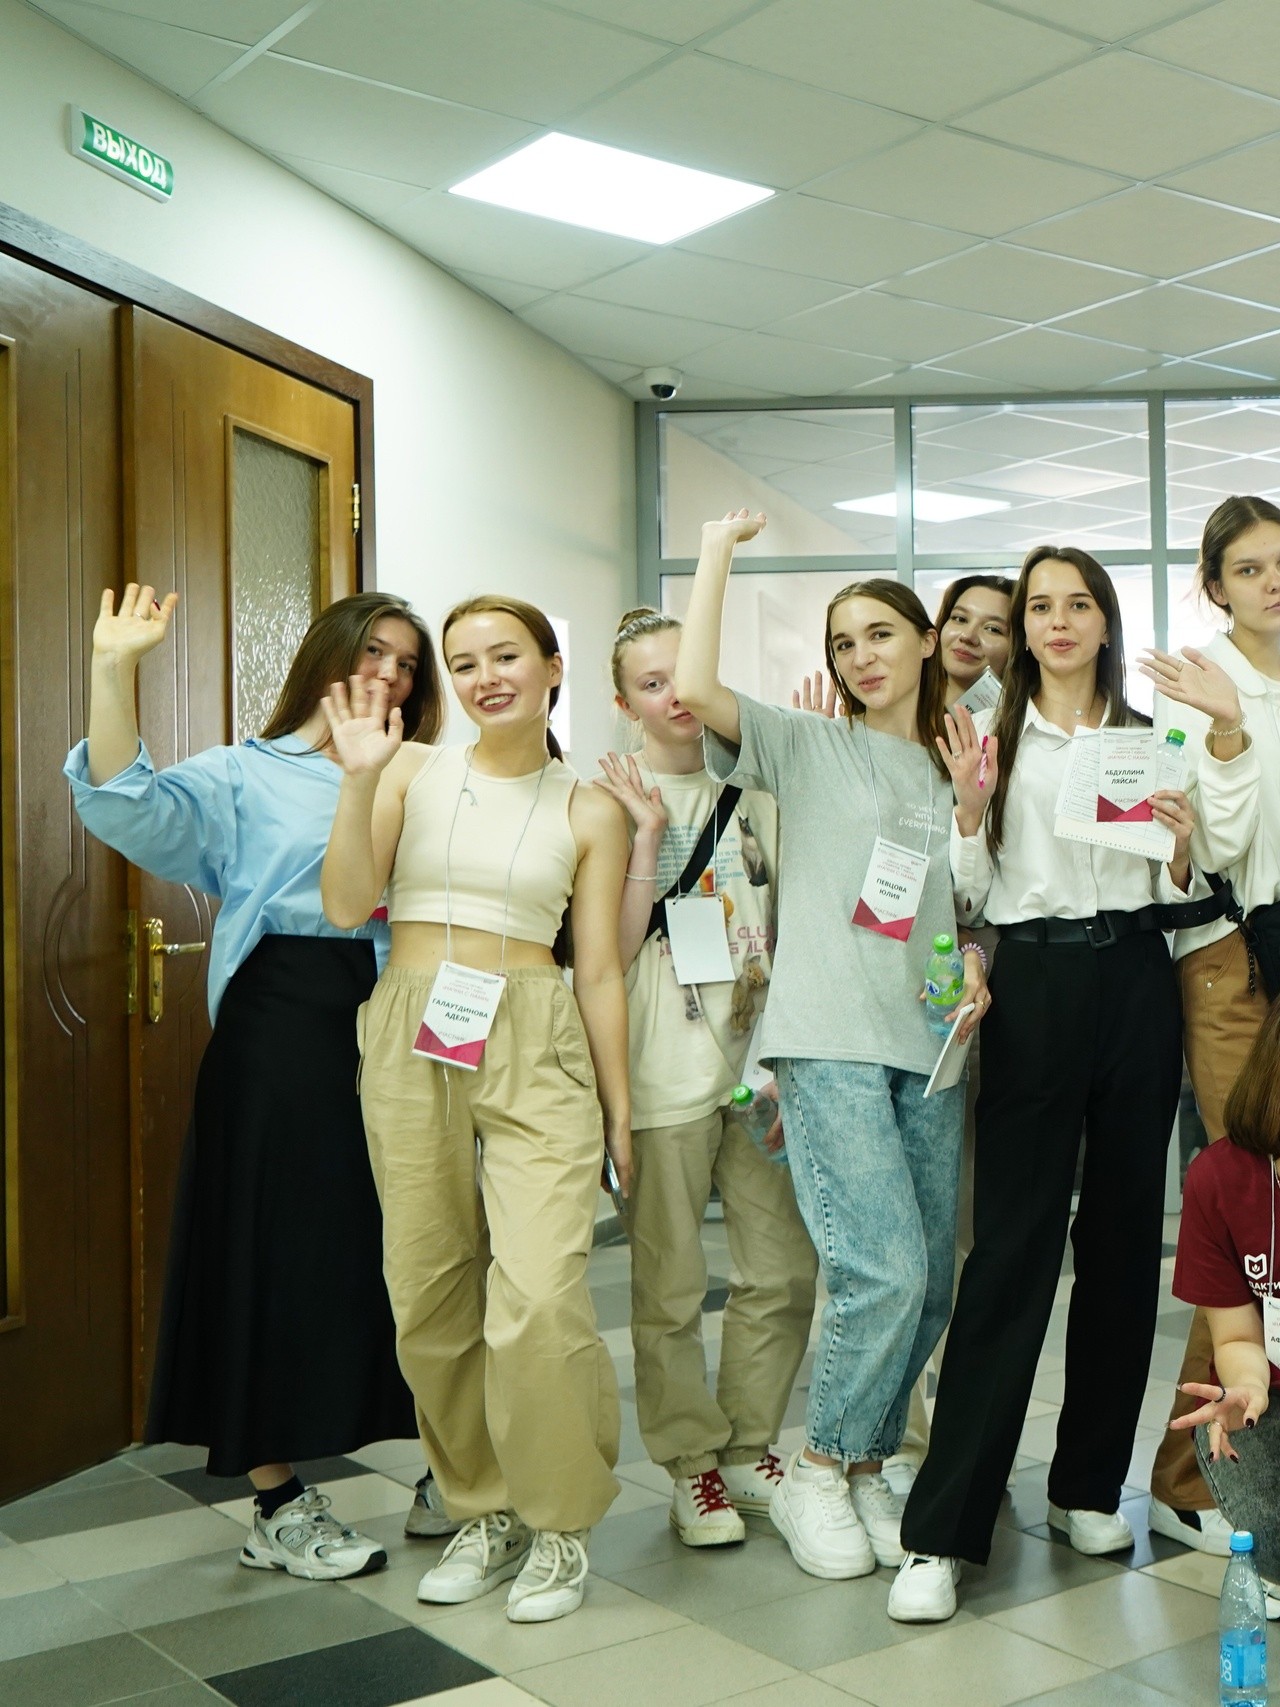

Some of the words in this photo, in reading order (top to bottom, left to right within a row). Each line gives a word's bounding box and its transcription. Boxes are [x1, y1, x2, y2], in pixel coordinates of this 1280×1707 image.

[92, 121, 168, 190] ВЫХОД
[1104, 769, 1145, 777] АБДУЛЛИНА
[1111, 777, 1138, 785] ЛЯЙСАН
[876, 877, 907, 894] ПЕВЦОВА
[879, 888, 901, 900] ЮЛИЯ
[431, 998, 489, 1019] ГАЛАУТДИНОВА
[444, 1011, 471, 1023] АДЕЛЯ
